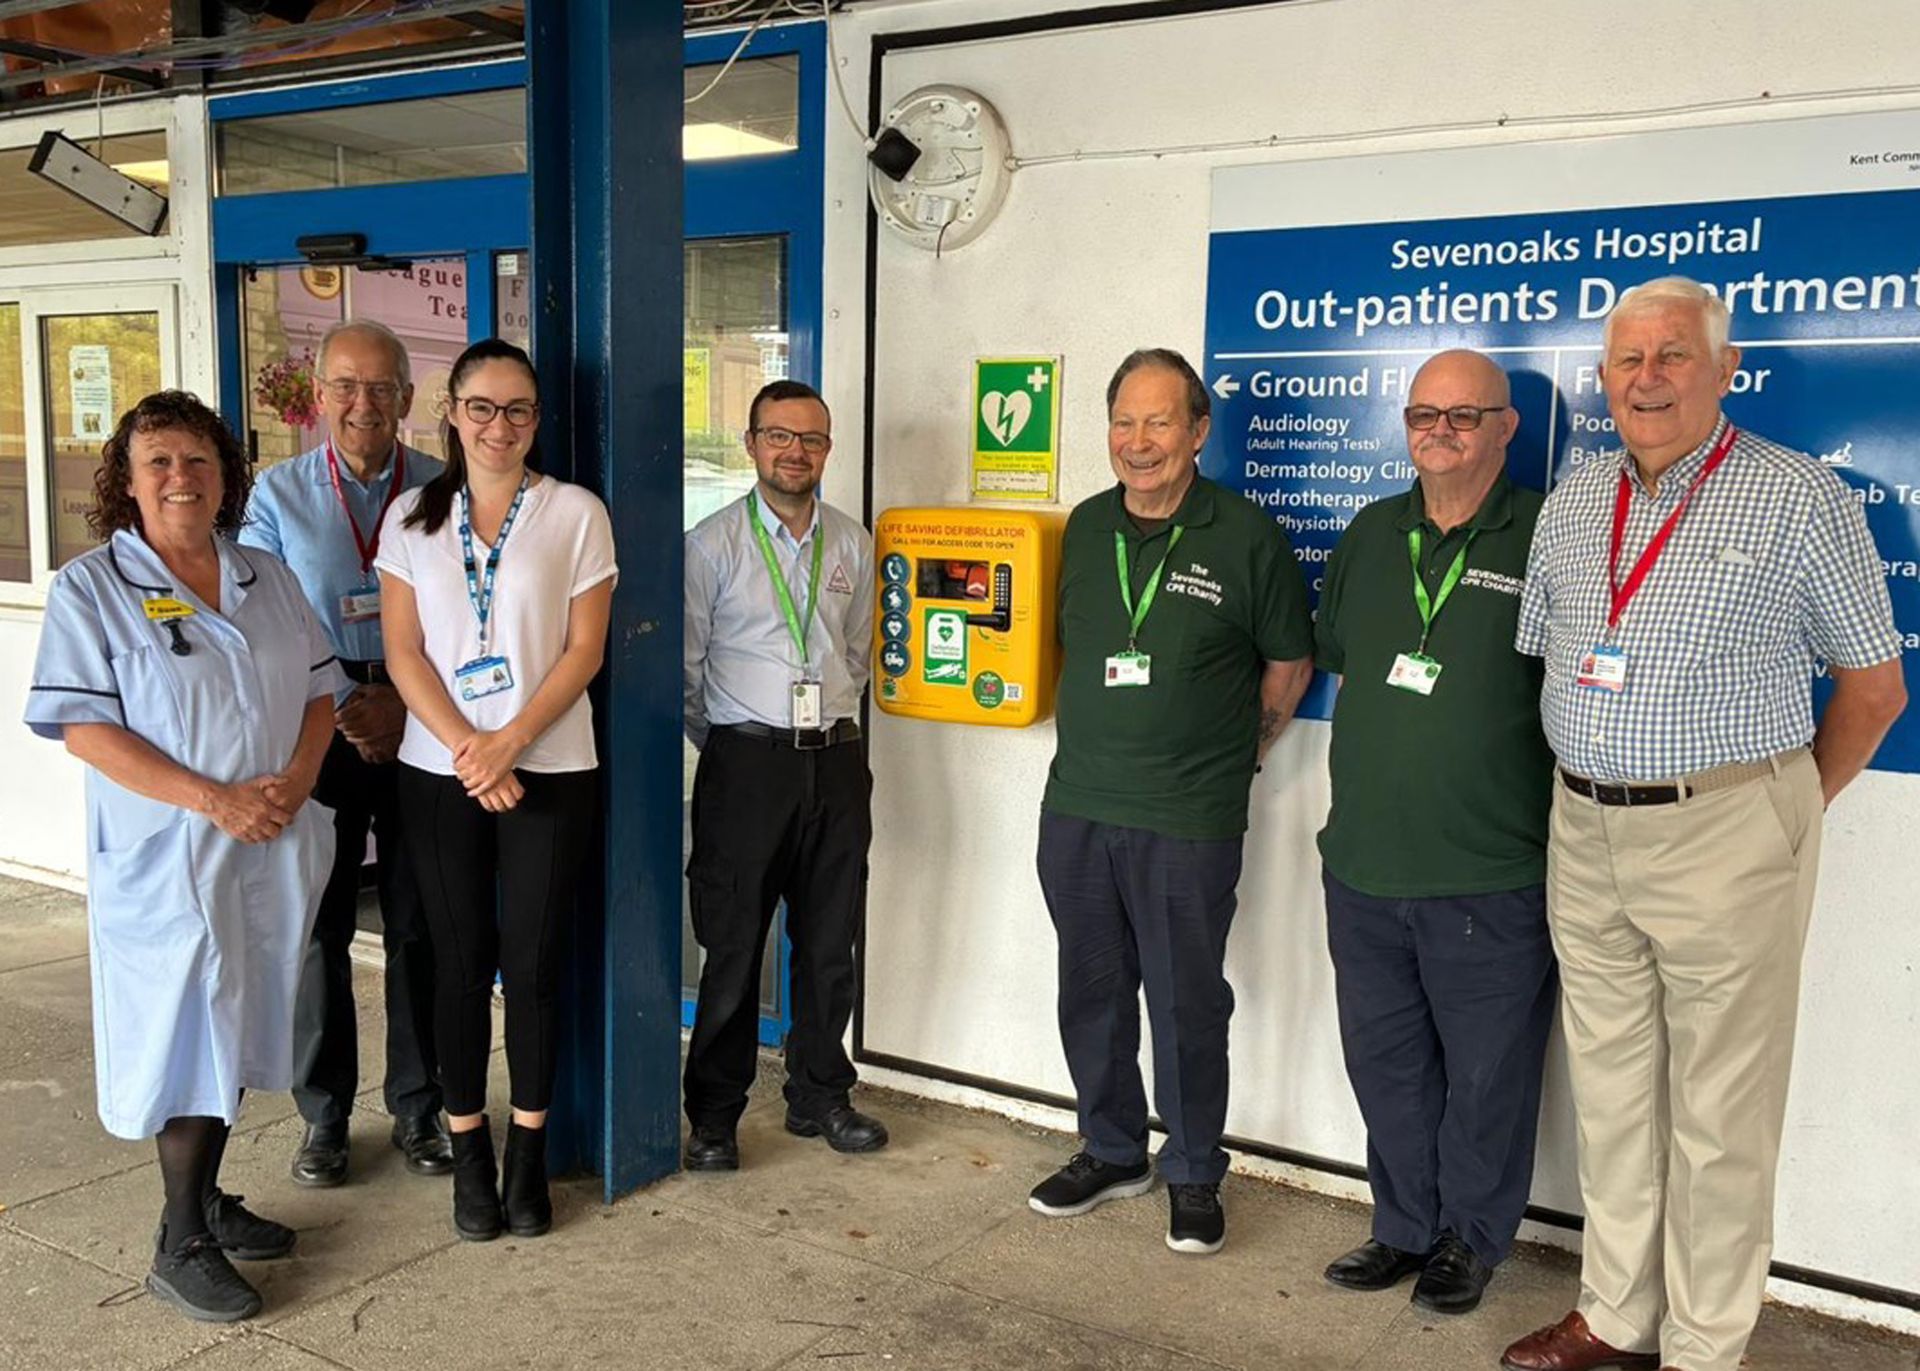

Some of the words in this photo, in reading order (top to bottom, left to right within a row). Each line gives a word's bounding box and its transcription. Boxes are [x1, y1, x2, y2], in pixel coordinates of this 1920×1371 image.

[1850, 154, 1879, 165] Kent
[1391, 230, 1580, 269] Sevenoaks
[1594, 217, 1762, 264] Hospital
[1255, 281, 1558, 337] Out-patients
[1578, 265, 1920, 320] Drtment
[1250, 367, 1368, 398] Ground
[1381, 366, 1413, 396] Fl
[1248, 413, 1350, 436] Audiology
[1246, 438, 1285, 451] (Adult
[1288, 438, 1339, 453] Hearing
[1343, 437, 1381, 452] Tests)
[1245, 461, 1374, 483] Dermatology
[883, 523, 902, 534] LIFE
[904, 524, 942, 536] SAVING
[944, 526, 1025, 538] DEFIBRILLATOR
[892, 537, 908, 545] CALL
[922, 538, 936, 546] FOR
[937, 539, 963, 548] ACCESS
[965, 540, 983, 548] CODE
[995, 541, 1014, 549] OPEN
[1191, 563, 1208, 576] The
[1166, 582, 1186, 593] CPR
[1187, 585, 1222, 606] Charity
